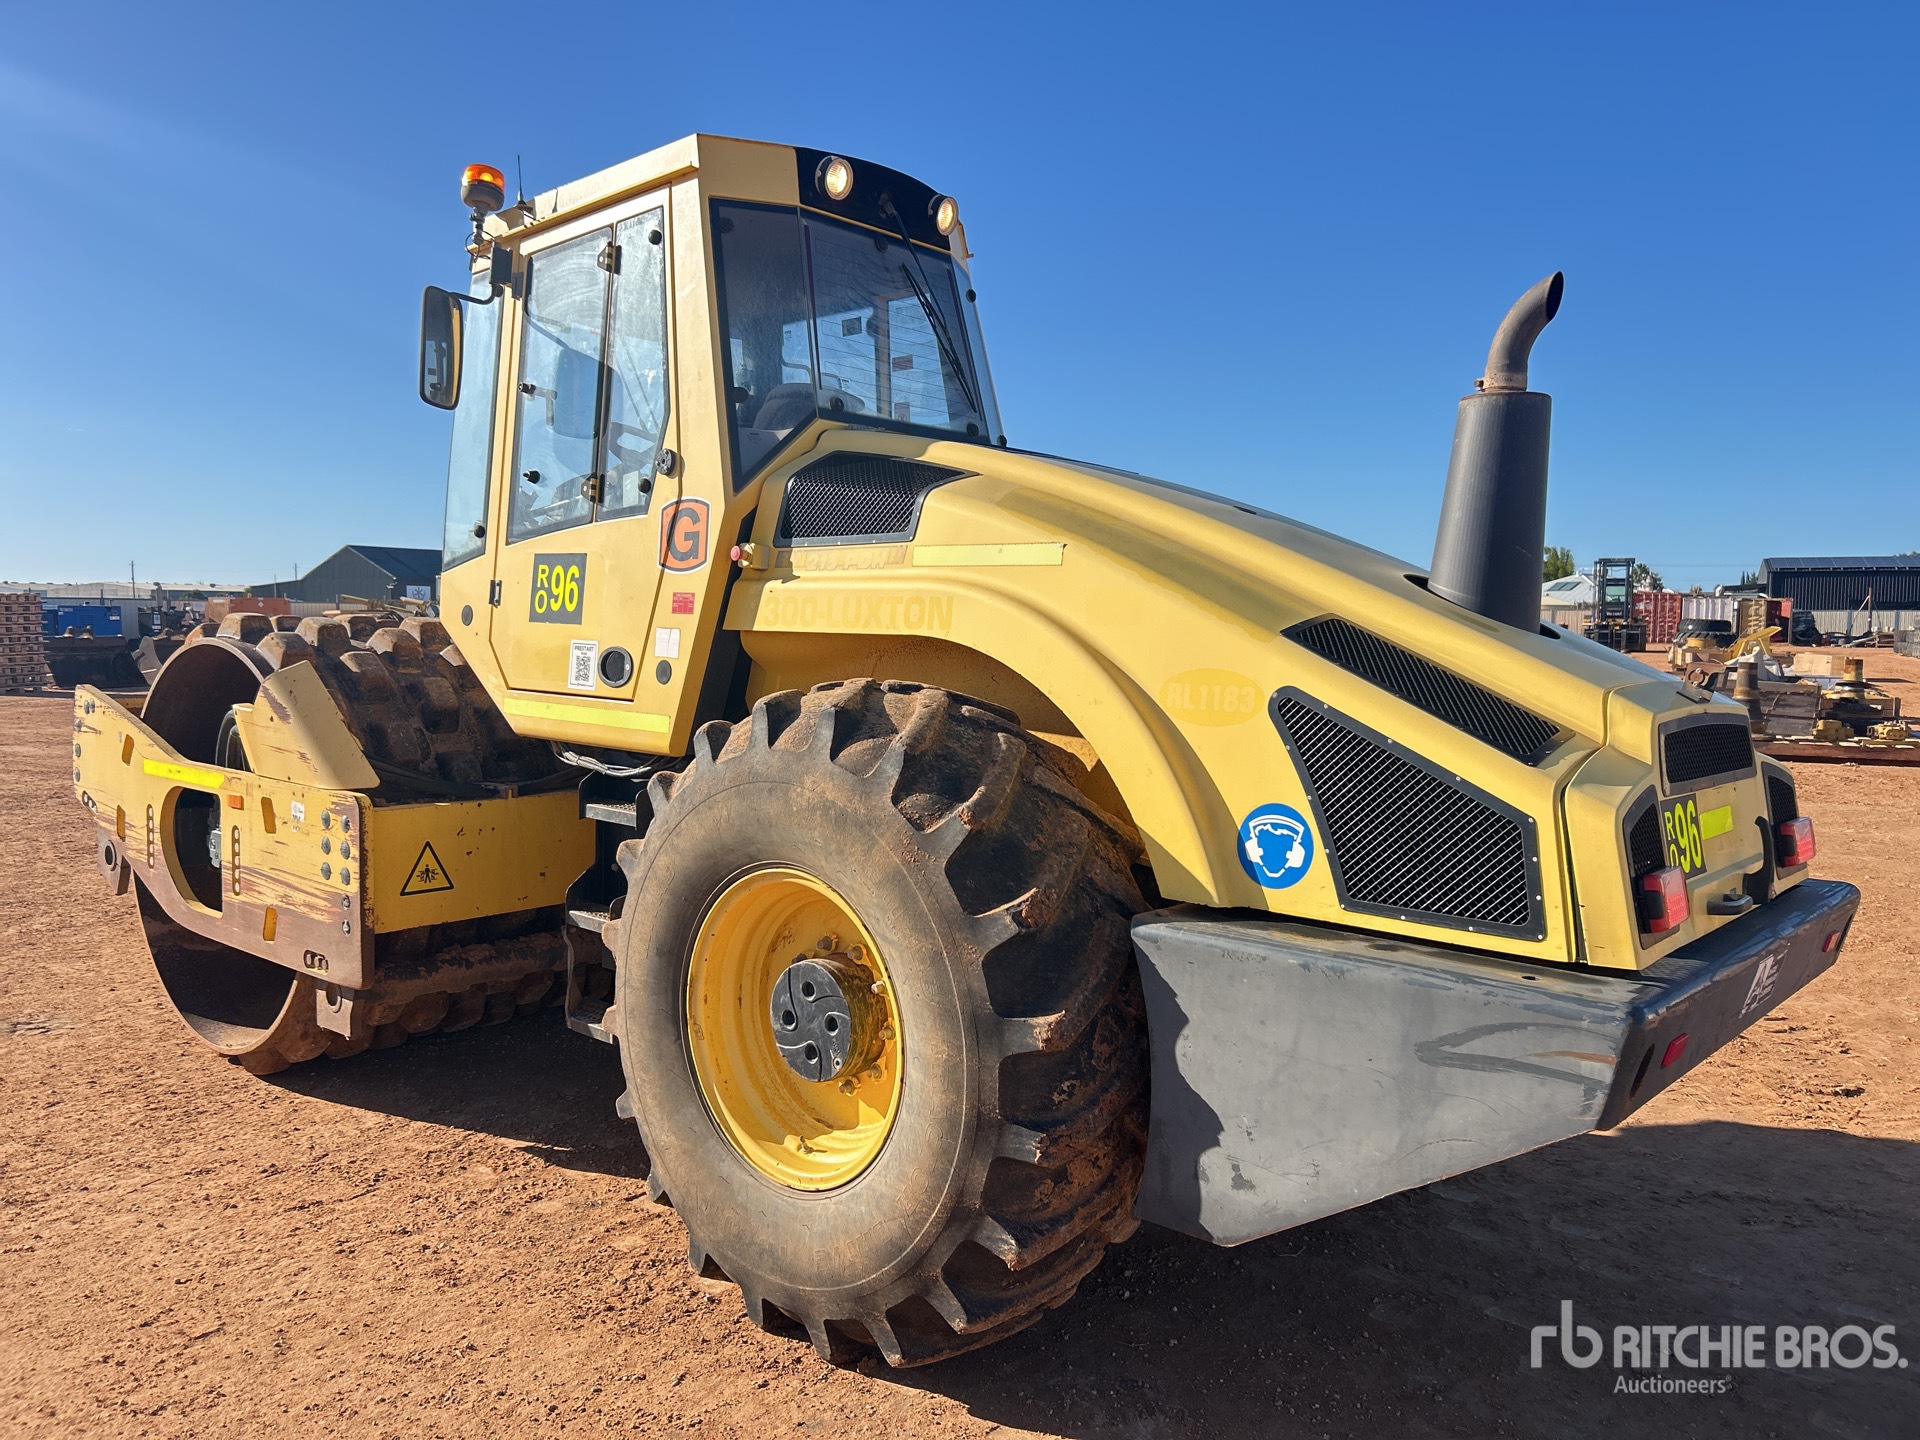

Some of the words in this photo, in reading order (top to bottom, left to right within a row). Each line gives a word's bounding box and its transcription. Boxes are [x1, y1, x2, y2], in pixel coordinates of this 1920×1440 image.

[665, 507, 701, 562] G
[550, 564, 580, 612] 96
[1674, 800, 1702, 874] 96
